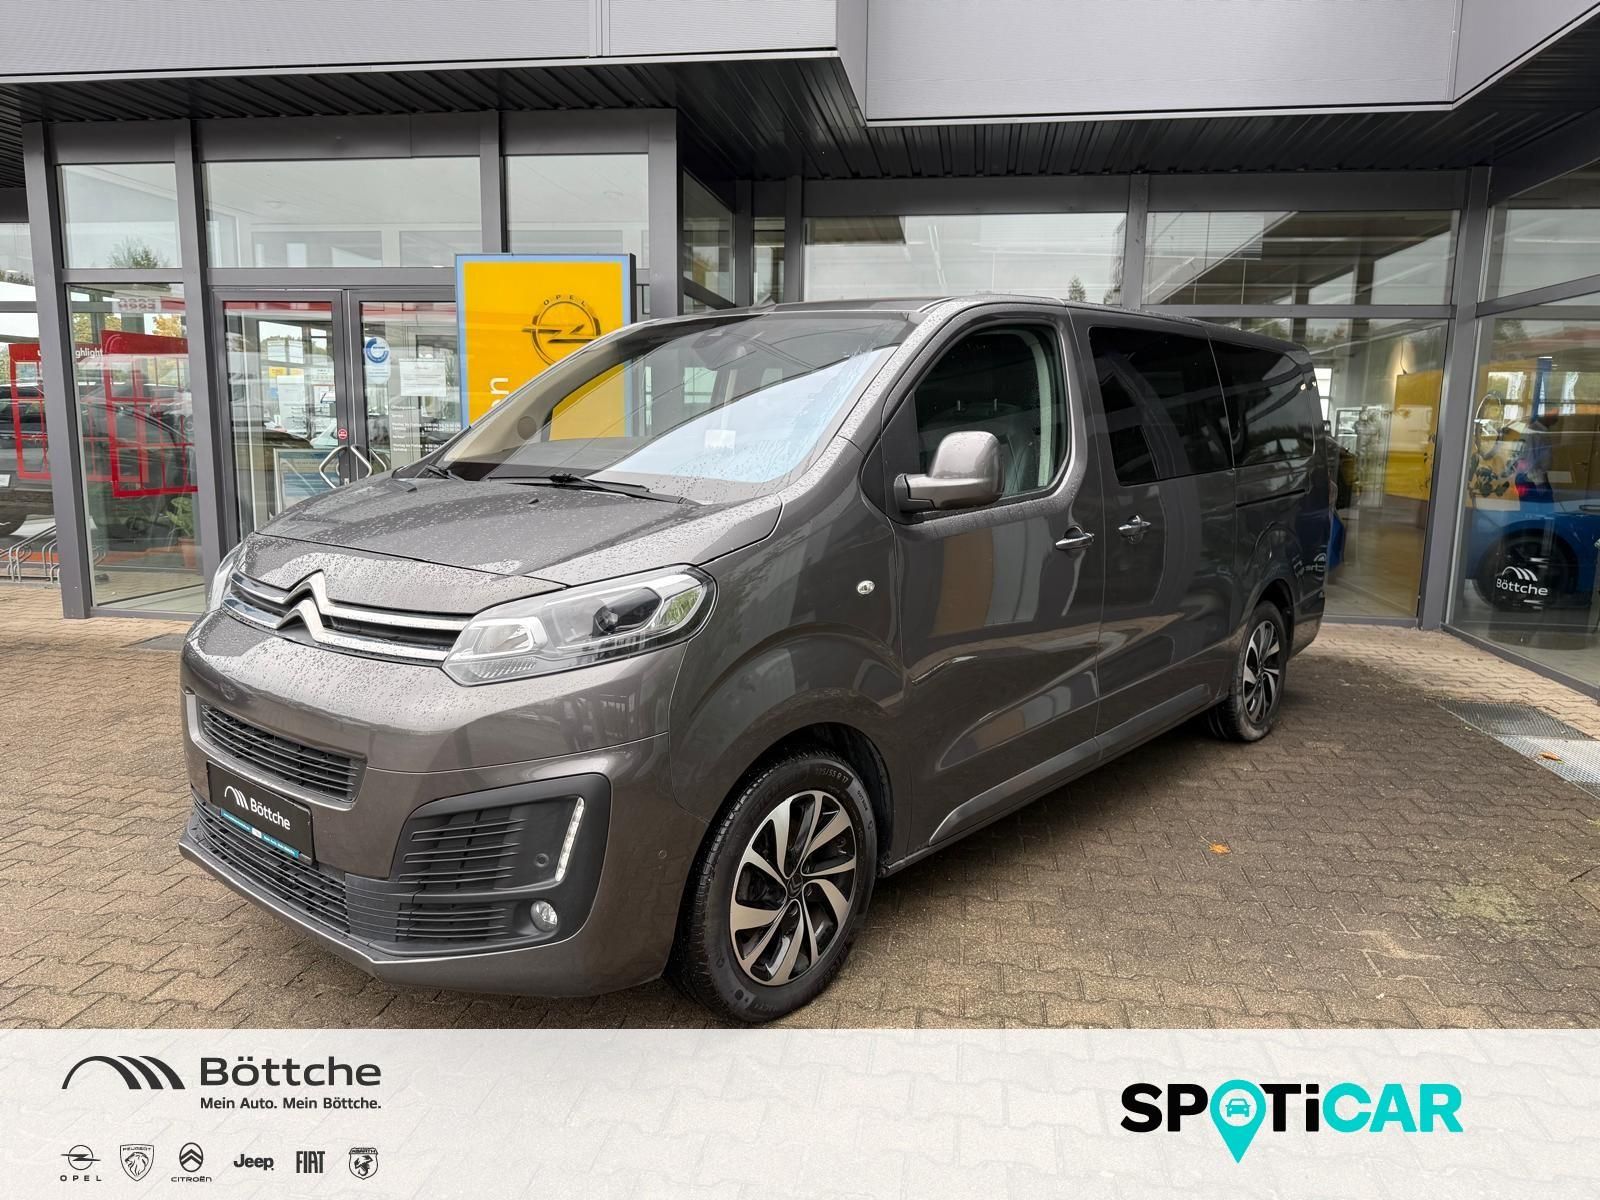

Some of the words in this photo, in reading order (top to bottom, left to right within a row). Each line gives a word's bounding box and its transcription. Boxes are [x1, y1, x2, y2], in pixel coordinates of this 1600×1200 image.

[543, 294, 587, 307] OPEL
[1496, 578, 1549, 595] Böttche
[250, 797, 291, 830] Böttche
